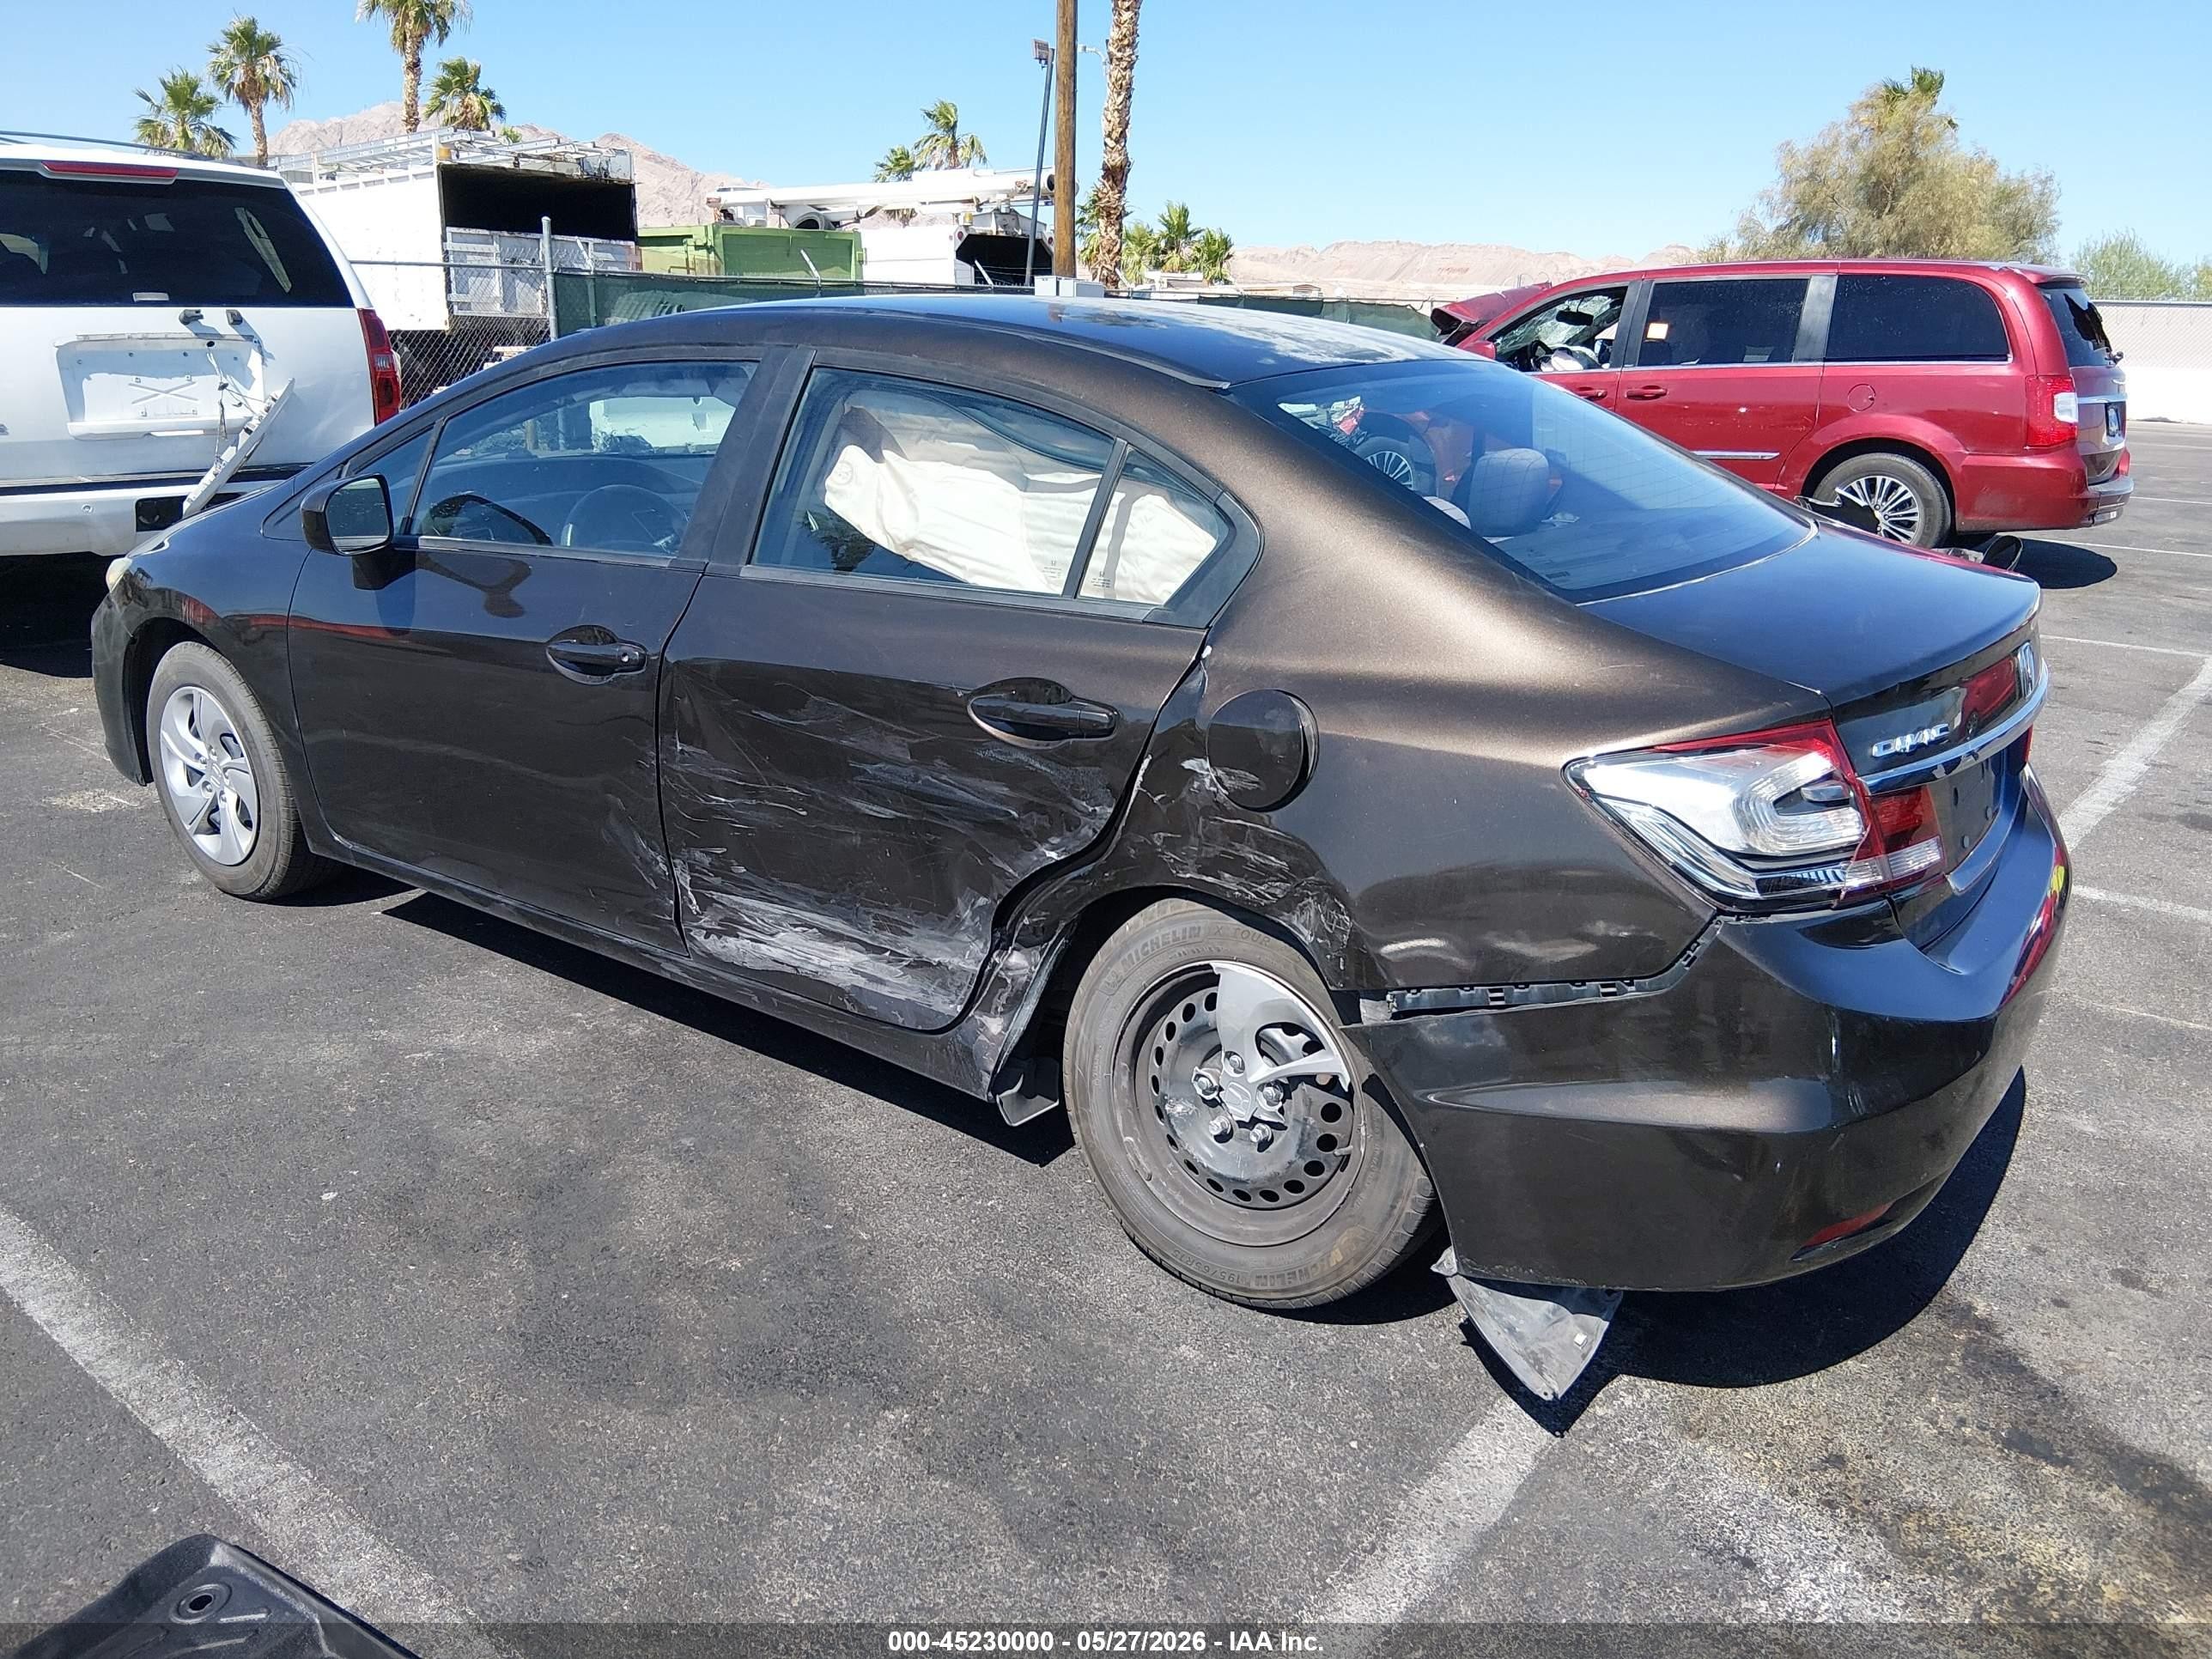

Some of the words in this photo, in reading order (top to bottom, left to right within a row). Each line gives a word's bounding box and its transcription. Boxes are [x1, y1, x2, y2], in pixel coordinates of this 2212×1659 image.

[1872, 723, 1950, 757] CIVIC
[1121, 925, 1201, 969] MICHELIN
[1234, 927, 1271, 946] TOUR
[1170, 1249, 1242, 1285] 195/65R15
